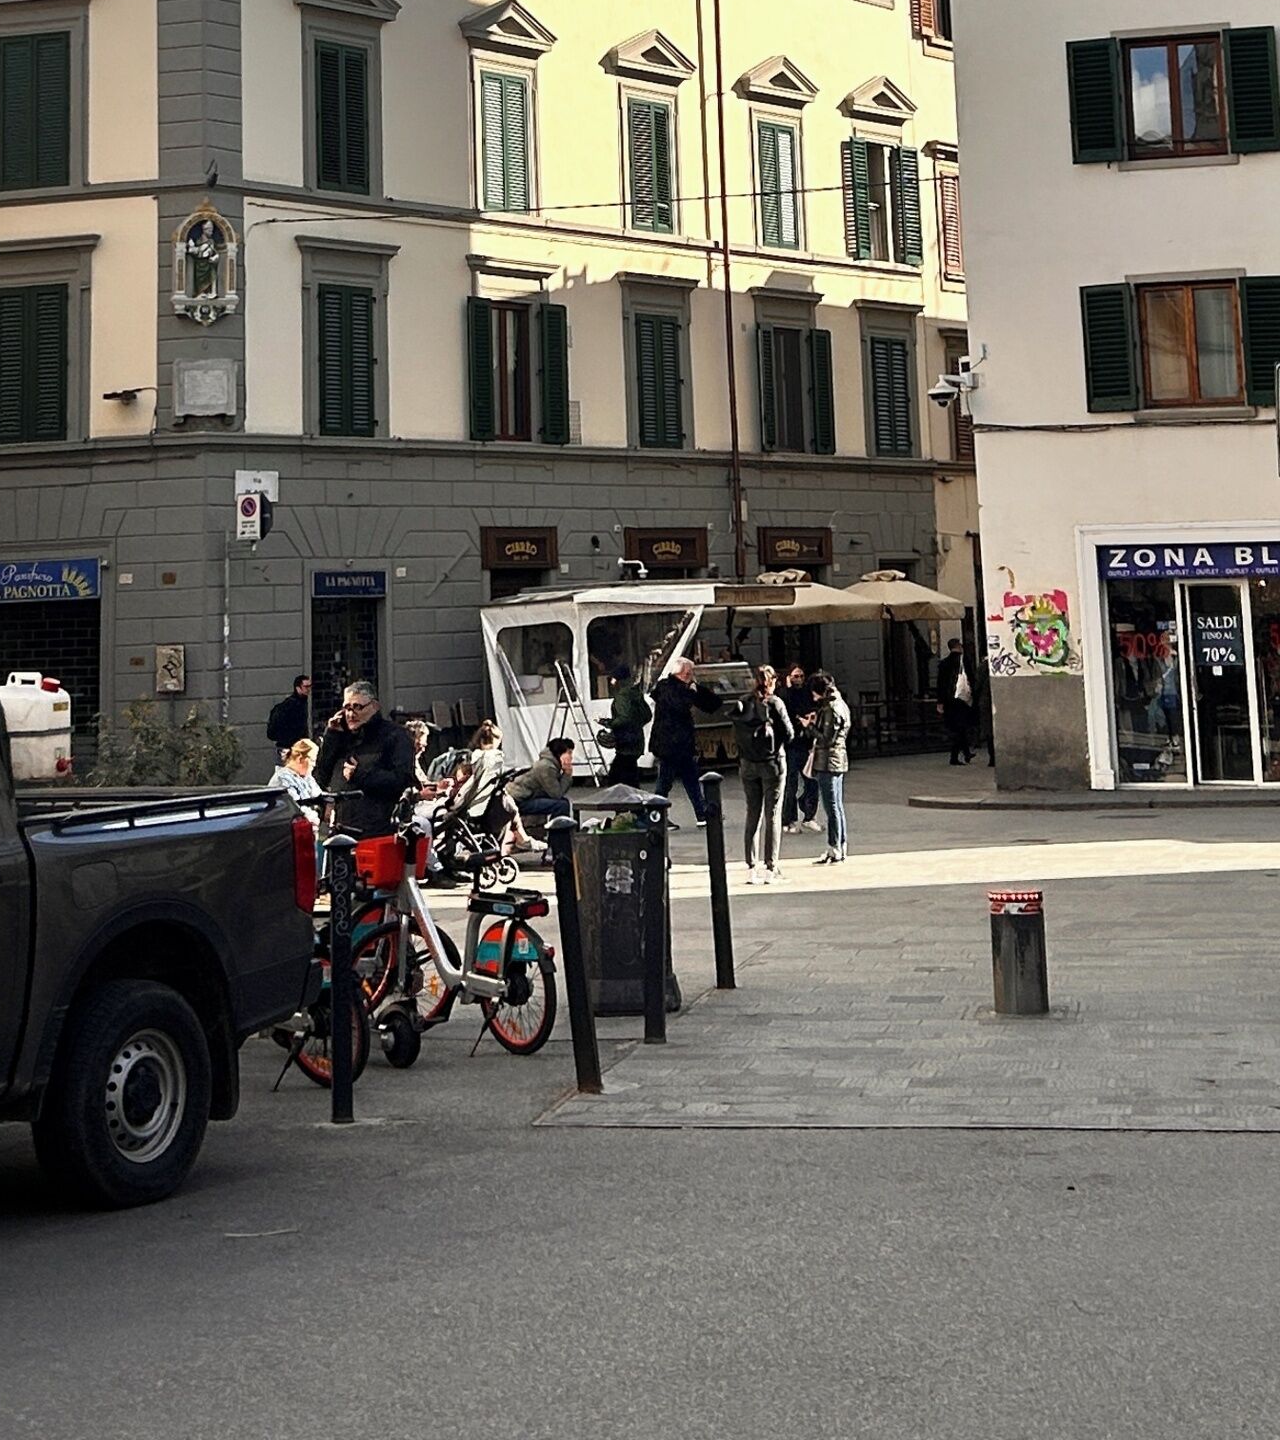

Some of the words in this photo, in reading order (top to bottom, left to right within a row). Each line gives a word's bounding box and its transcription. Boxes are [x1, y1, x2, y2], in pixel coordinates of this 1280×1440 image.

[1109, 546, 1215, 568] ZONA
[325, 576, 336, 587] LA
[4, 584, 71, 599] PAGNOTTA
[1197, 616, 1238, 629] SALDI
[1202, 631, 1221, 640] FINO
[1202, 647, 1237, 662] 70%
